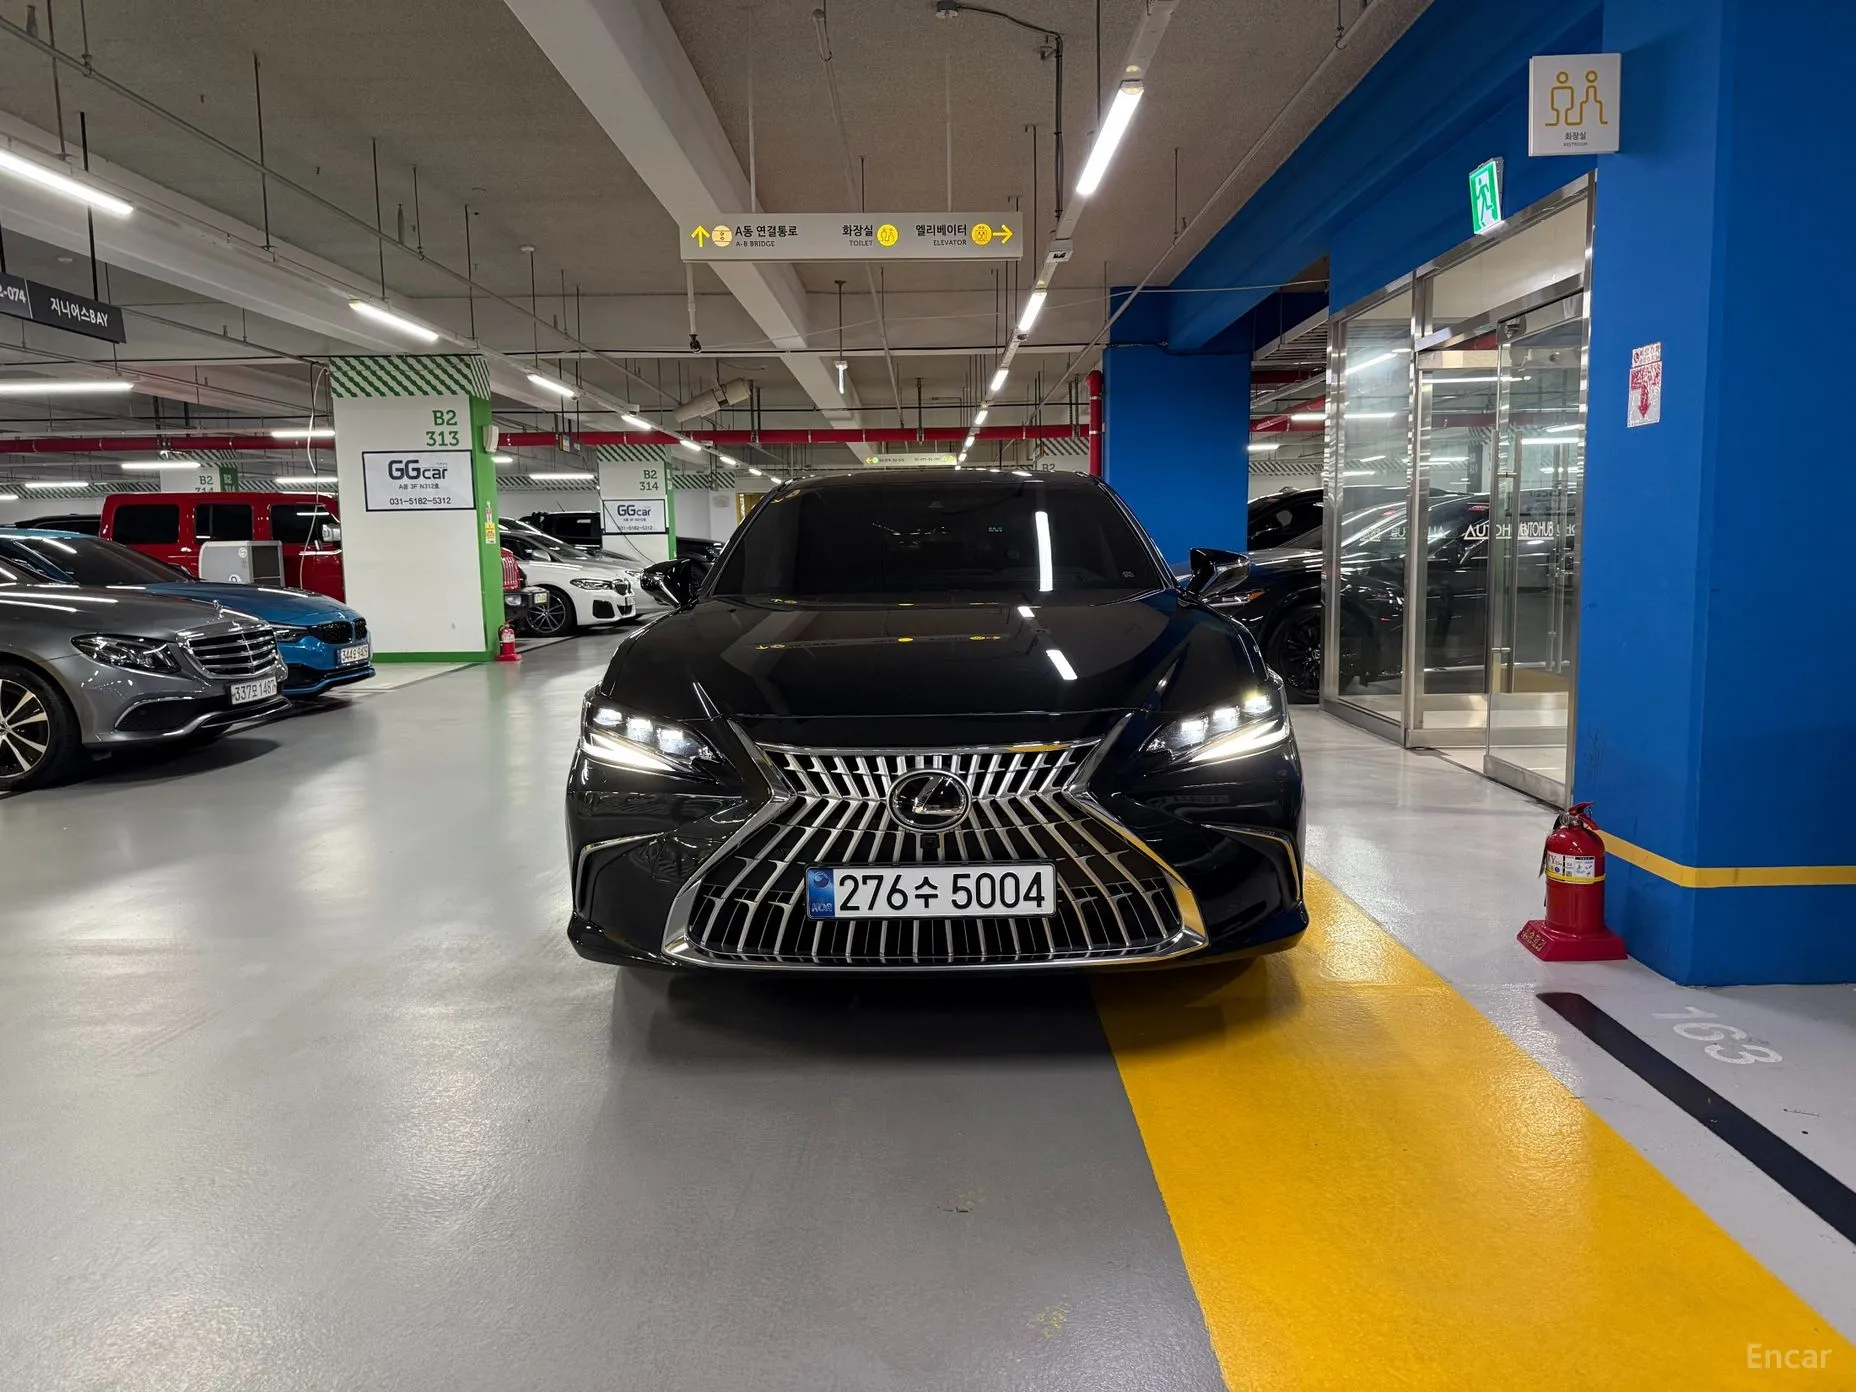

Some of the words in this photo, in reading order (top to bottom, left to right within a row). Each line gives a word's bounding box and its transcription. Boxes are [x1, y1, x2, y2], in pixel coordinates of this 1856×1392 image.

[1565, 132, 1587, 140] 화장실
[735, 226, 753, 237] A동
[756, 226, 798, 237] 연결통로
[842, 225, 873, 237] 화장실
[915, 224, 967, 237] 엘리베이터
[50, 297, 108, 327] 지니어스BAY
[432, 410, 458, 426] B2
[426, 431, 460, 446] 313
[199, 475, 214, 485] B2
[643, 469, 657, 479] B2
[639, 481, 659, 491] 314
[389, 497, 452, 506] 031-5182-5312
[839, 874, 938, 911] 276수
[951, 871, 1046, 910] 5004
[1651, 1006, 1783, 1065] 163
